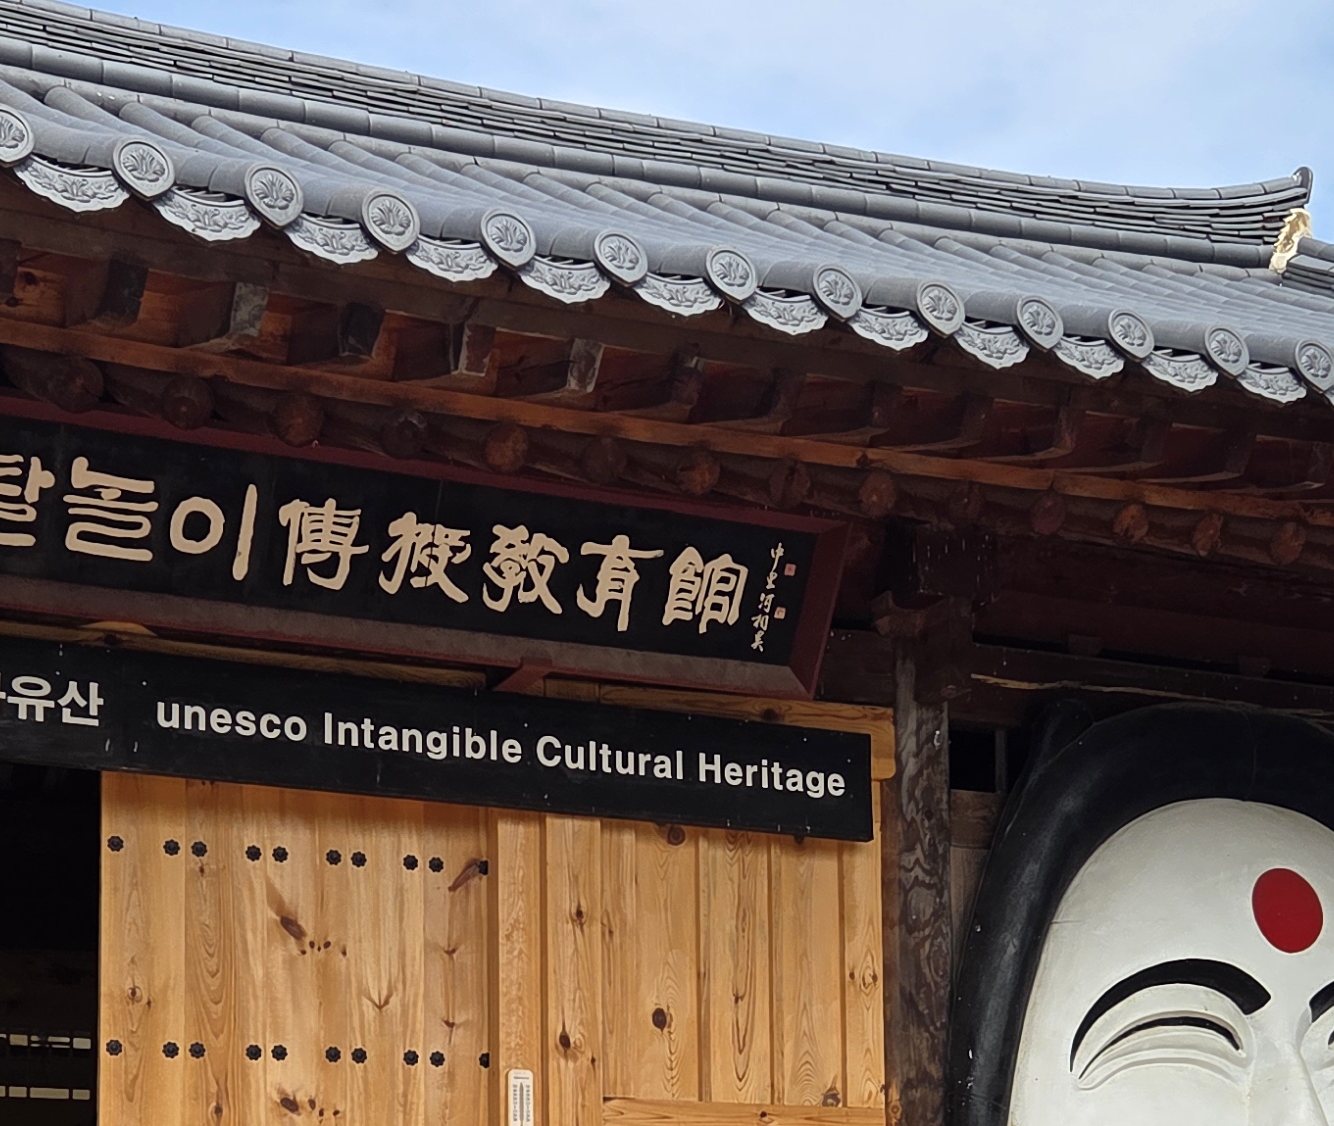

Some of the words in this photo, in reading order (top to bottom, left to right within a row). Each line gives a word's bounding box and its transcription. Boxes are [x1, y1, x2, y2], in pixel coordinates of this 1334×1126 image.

[157, 698, 307, 743] unesco
[323, 712, 523, 764] Intangible
[535, 734, 685, 781] Cultural
[698, 752, 847, 799] Heritage
